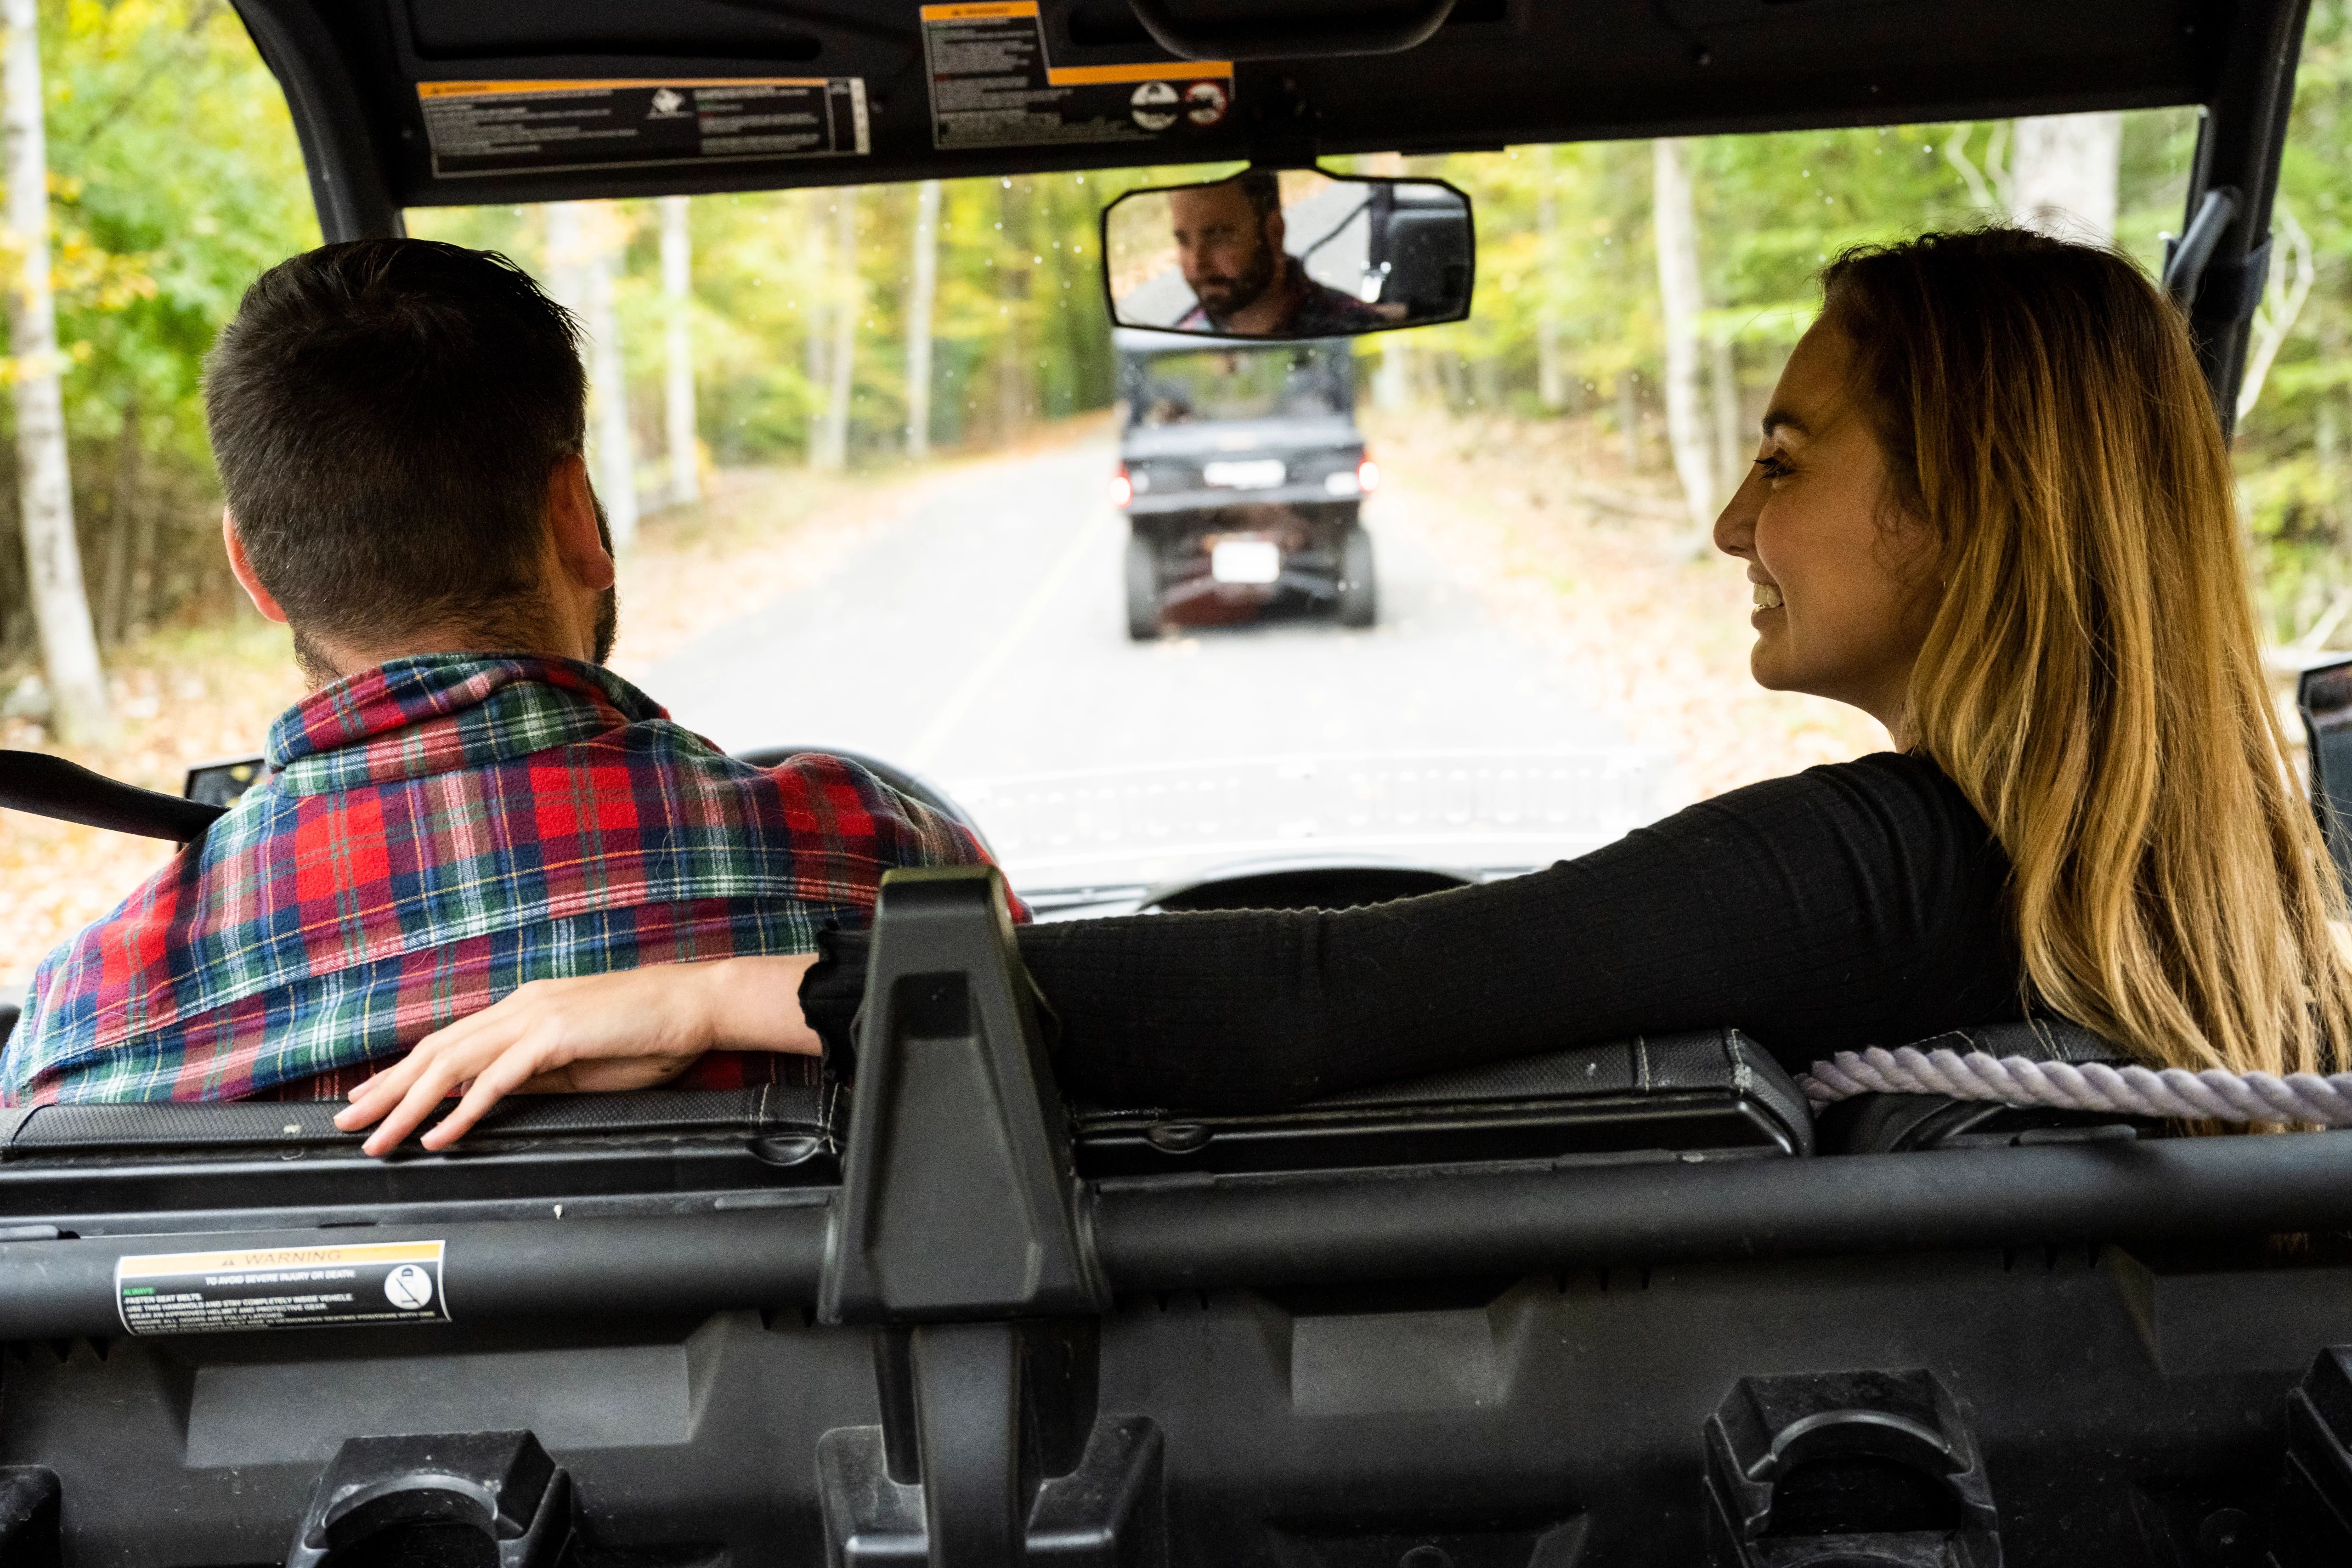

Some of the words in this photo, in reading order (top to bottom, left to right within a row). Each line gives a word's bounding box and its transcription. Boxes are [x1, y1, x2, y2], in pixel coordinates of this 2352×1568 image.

[245, 1250, 341, 1265] WARNING
[205, 1276, 218, 1286] TO
[218, 1275, 244, 1285] AVOID
[245, 1273, 278, 1284] SEVERE
[279, 1271, 310, 1282] INJURY
[310, 1270, 324, 1280] OR
[156, 1295, 176, 1303] SEAT
